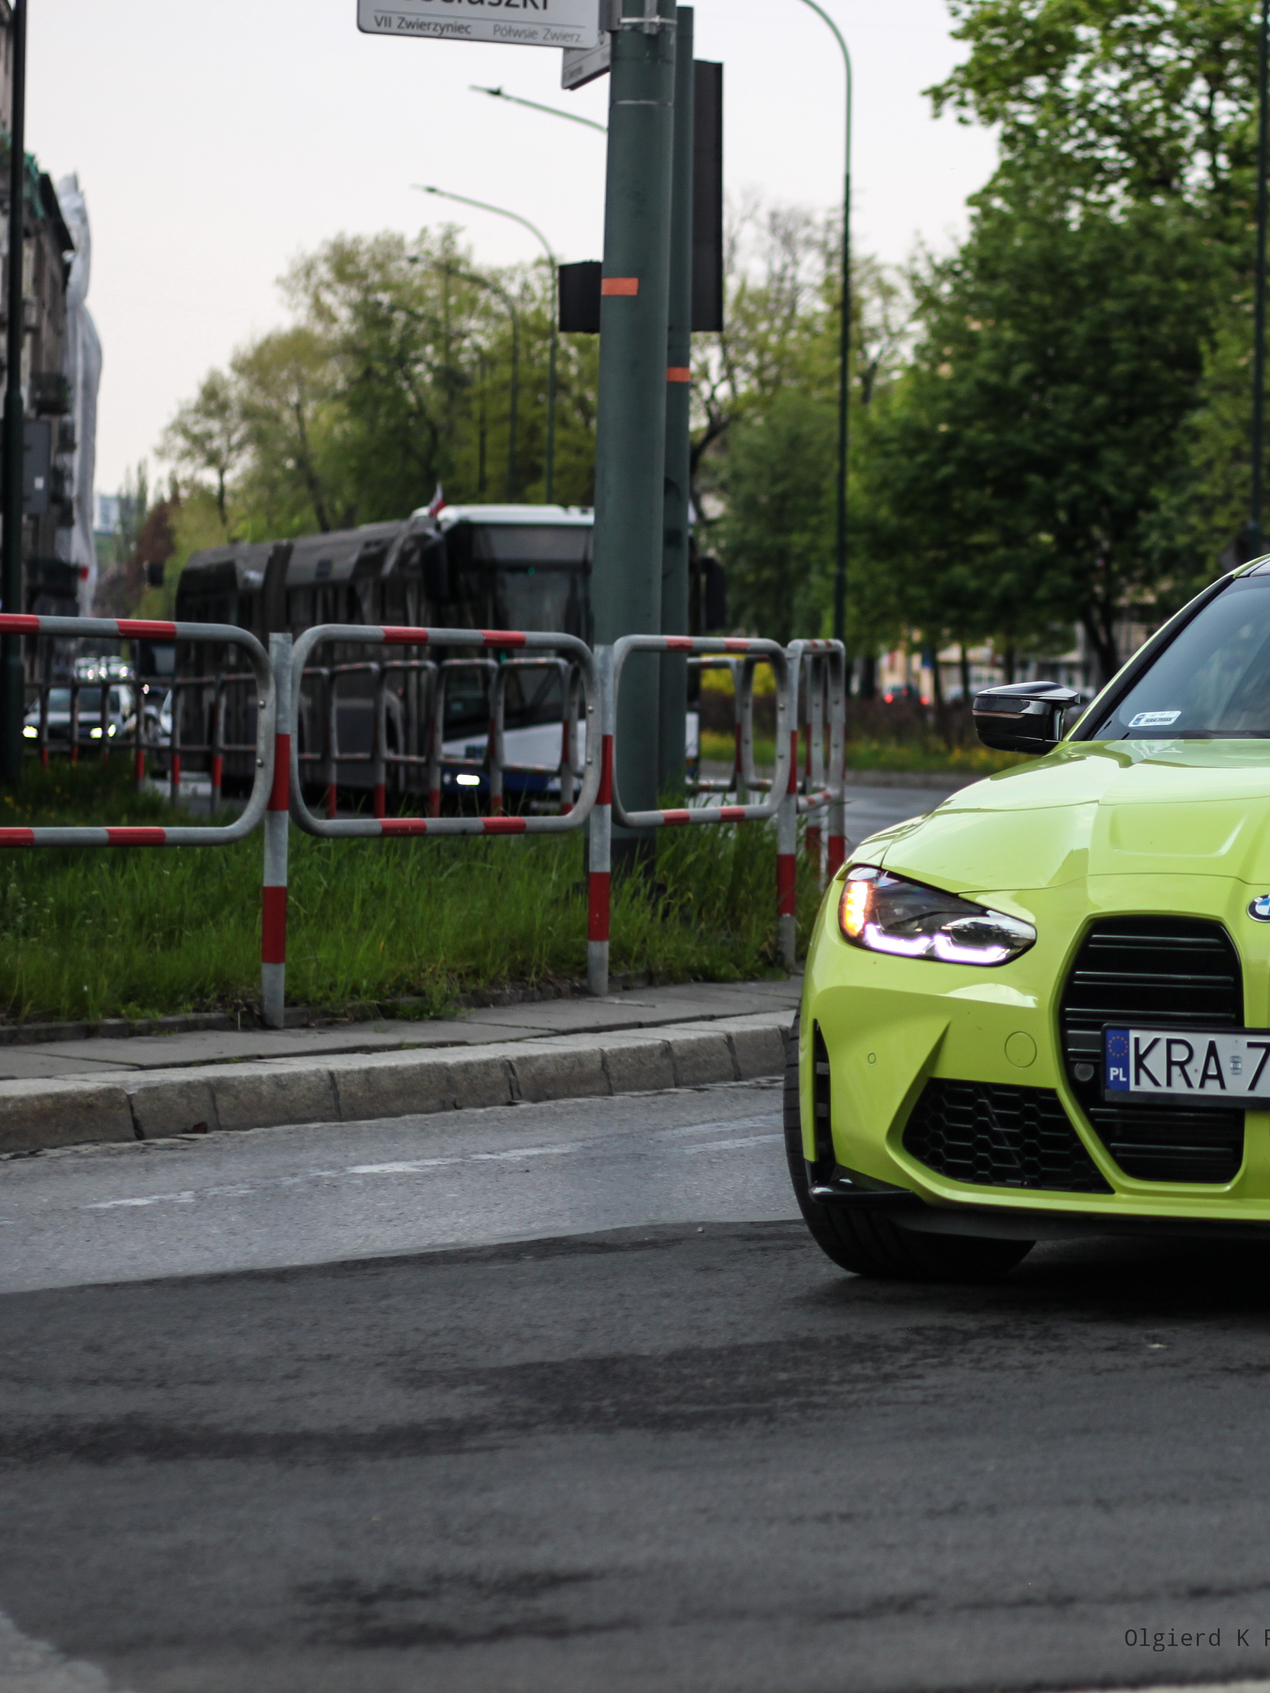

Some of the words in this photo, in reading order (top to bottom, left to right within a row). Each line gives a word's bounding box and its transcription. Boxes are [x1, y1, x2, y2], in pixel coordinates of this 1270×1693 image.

[374, 15, 392, 28] VII
[397, 16, 472, 36] Zwierzyniec
[493, 24, 539, 40] Półwsie
[542, 28, 583, 43] Zwierz.
[1133, 1036, 1226, 1090] KRA
[1109, 1067, 1127, 1081] PL
